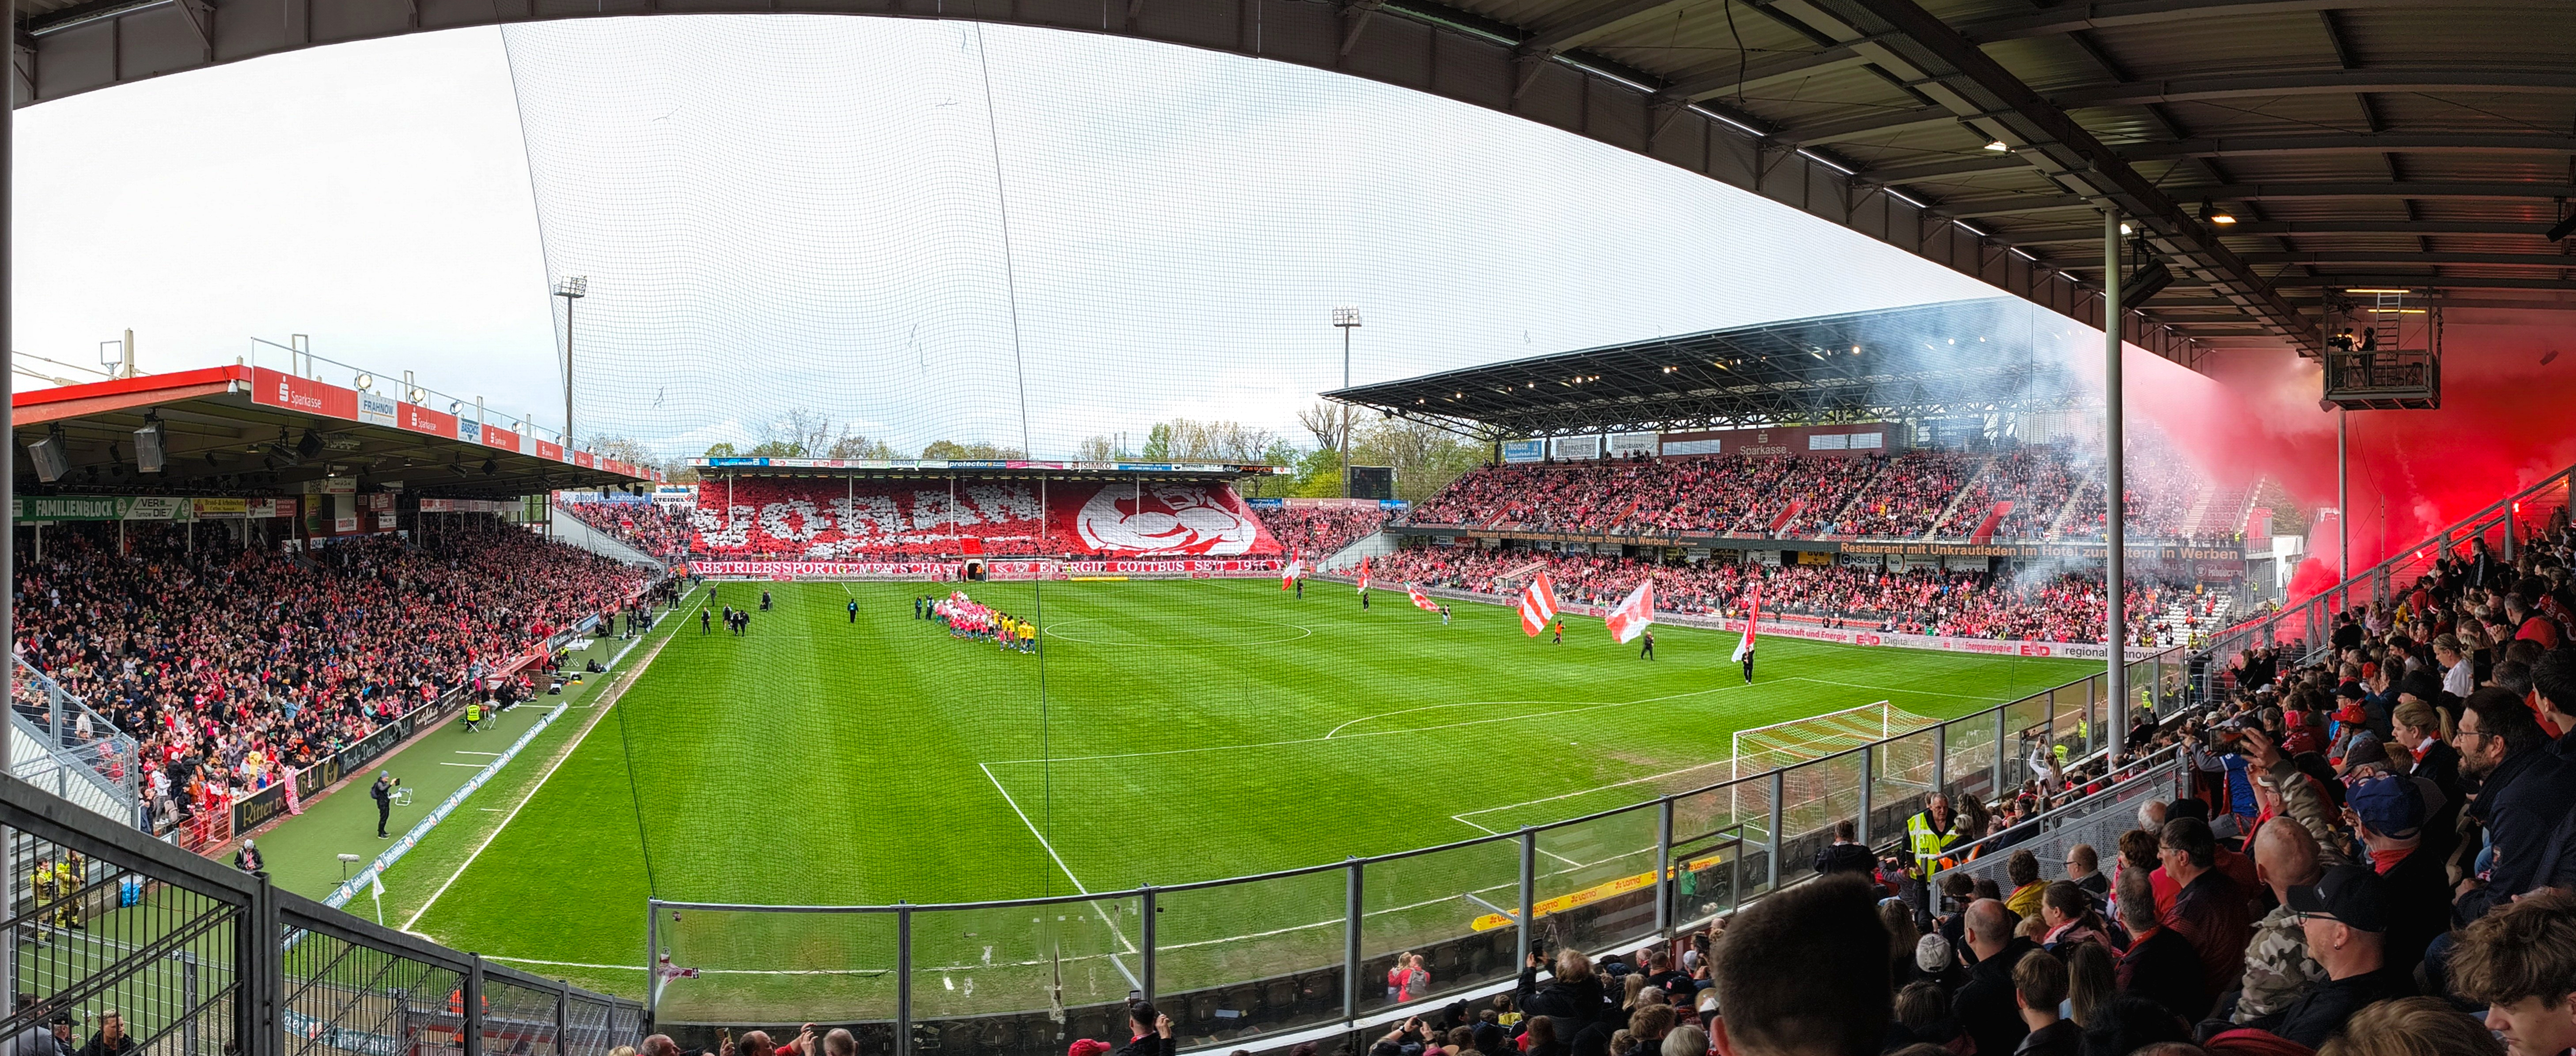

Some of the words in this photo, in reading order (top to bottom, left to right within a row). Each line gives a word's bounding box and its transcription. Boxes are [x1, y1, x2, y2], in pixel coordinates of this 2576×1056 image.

[291, 391, 321, 409] Sparkasse
[364, 400, 394, 415] FRAHNOW
[418, 418, 436, 431] Sparkasse
[1740, 444, 1786, 456] Sparkasse
[36, 500, 113, 517] FAMILIENBLOCK
[141, 499, 159, 507] VER
[1512, 532, 1555, 540] Unkrautladen
[1638, 536, 1669, 545] Werben
[1841, 542, 1904, 554] Restaurant
[1907, 544, 1926, 554] mit
[1930, 544, 2016, 556] Unkrautladen
[2021, 545, 2037, 556] im
[2042, 545, 2078, 556] Hotel
[2162, 547, 2174, 558] in
[2180, 547, 2238, 560] Werben
[1117, 561, 1185, 572] COTTBUS
[1194, 560, 1227, 571] SEIT
[1568, 605, 1584, 613] Energie
[1763, 626, 1805, 636] Leidenschaft
[1807, 629, 1820, 638] und
[1821, 631, 1847, 641] Energie
[343, 748, 361, 774] Finde
[361, 744, 376, 761] Dein
[242, 800, 273, 827] Ritter
[1694, 860, 1711, 869] LOTTO
[1622, 876, 1641, 887] LOTTO
[1579, 889, 1597, 901] LOTTO
[1539, 900, 1558, 912] LOTTO
